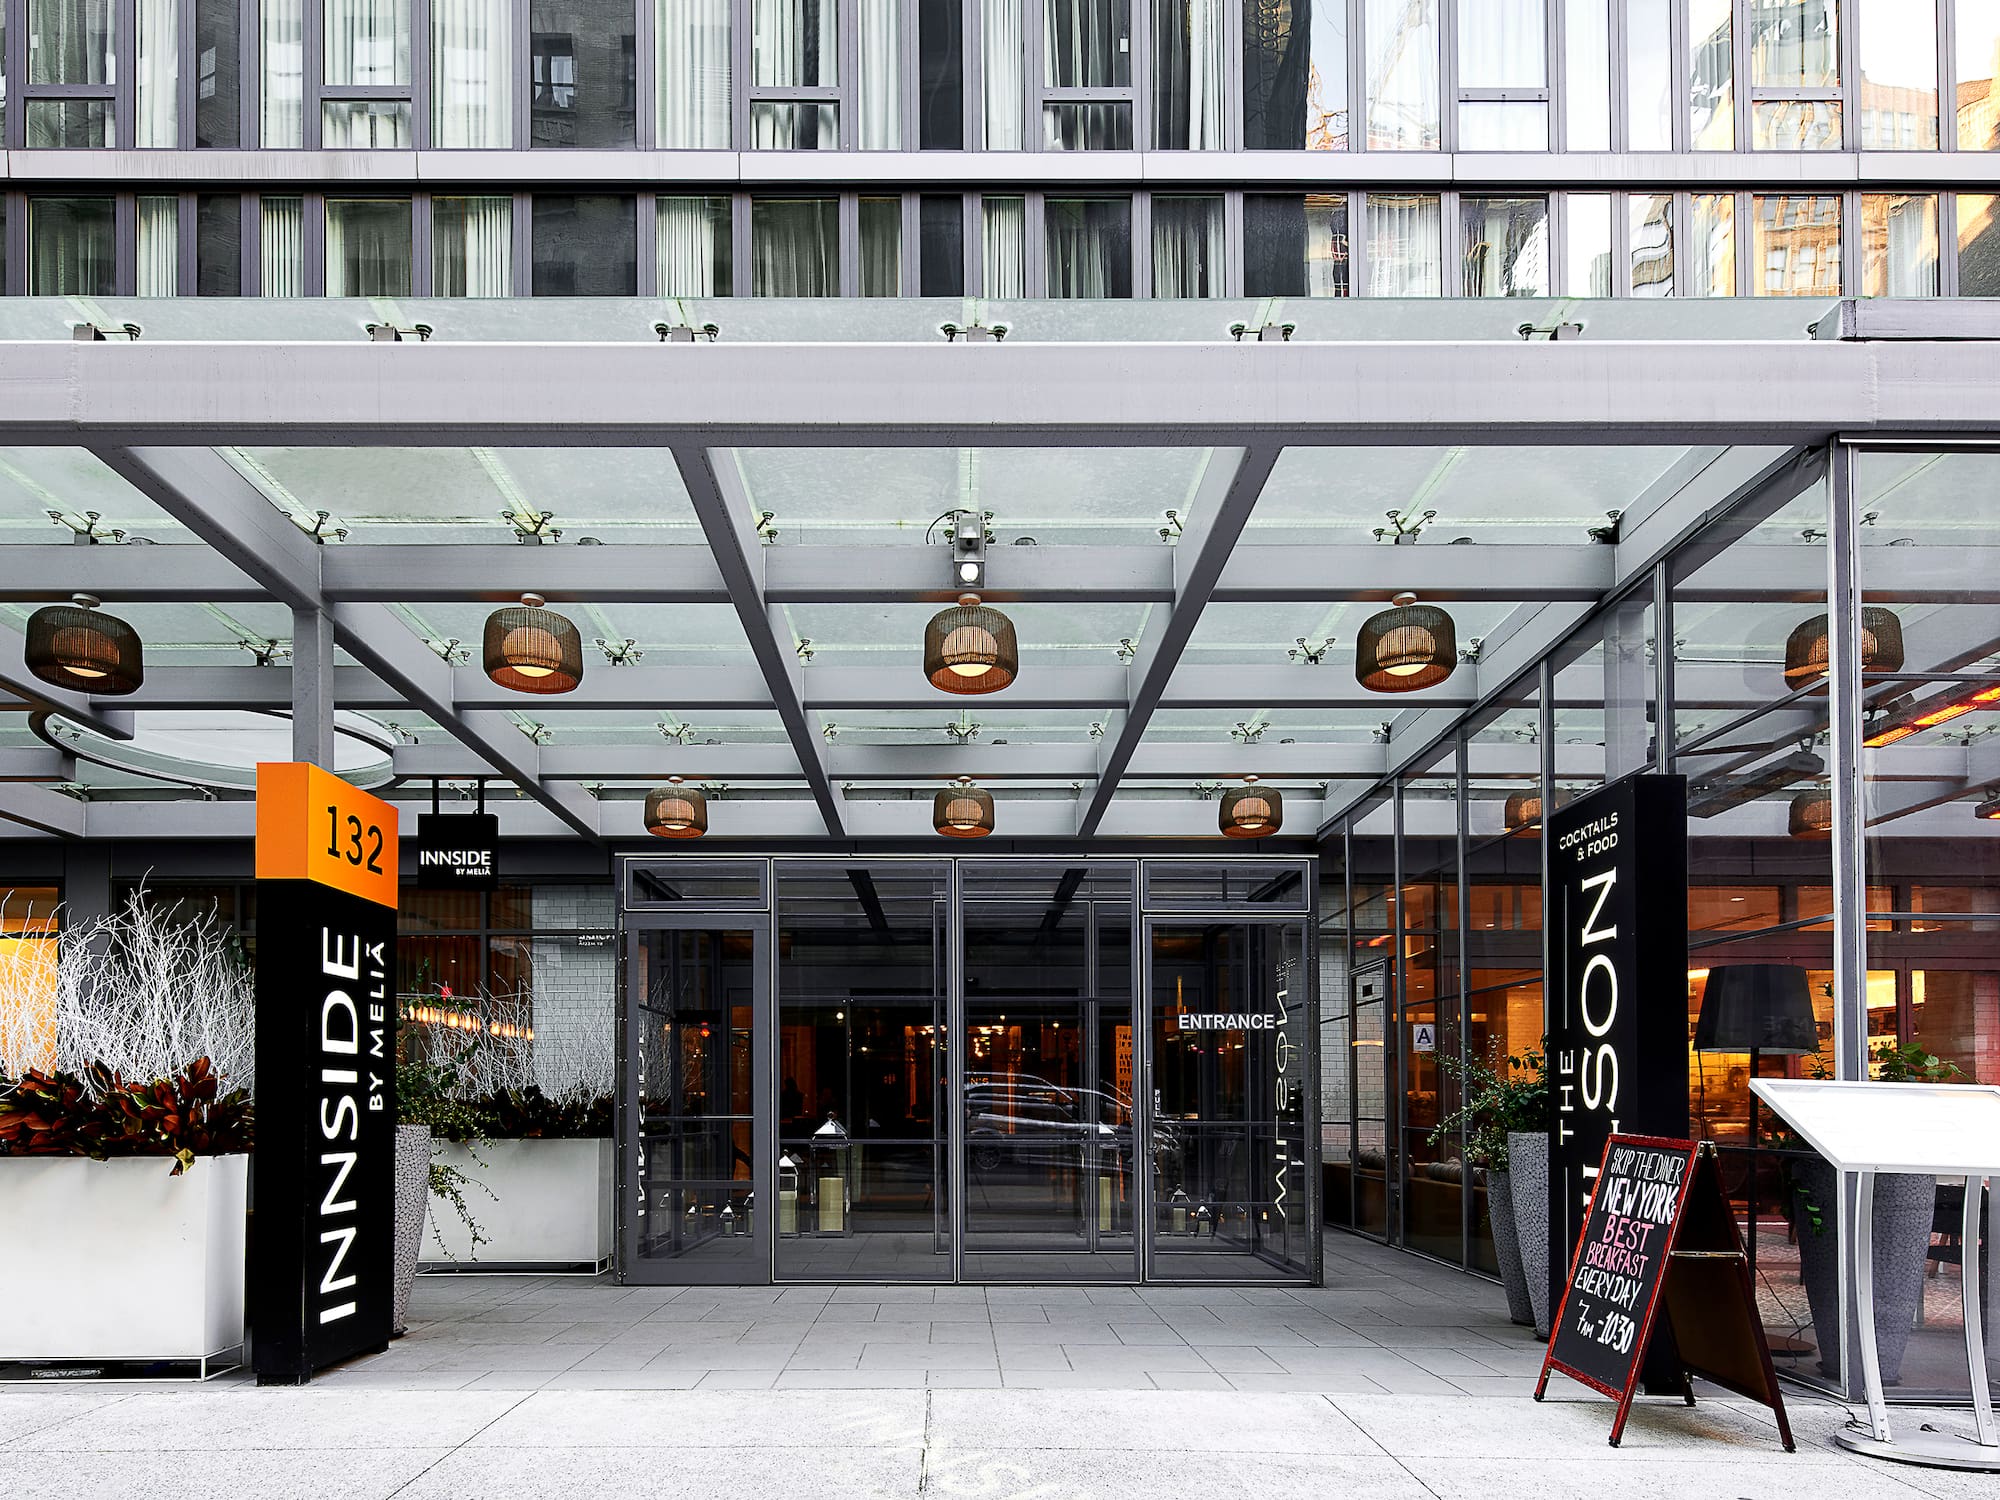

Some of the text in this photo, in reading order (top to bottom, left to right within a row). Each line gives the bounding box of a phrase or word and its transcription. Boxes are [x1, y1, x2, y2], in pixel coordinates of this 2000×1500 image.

[327, 805, 383, 876] 132
[1559, 812, 1618, 850] COCKTAILS
[1577, 833, 1618, 861] & FOOD
[420, 850, 491, 865] INNSIDE
[1178, 1014, 1274, 1030] ENTRANCE
[1417, 1028, 1431, 1043] A
[369, 1072, 384, 1110] BY
[1560, 1049, 1574, 1146] THE
[320, 926, 359, 1325] INNSIDE
[1611, 1147, 1635, 1175] SKIP
[1601, 1177, 1641, 1216] NEW
[1602, 1215, 1654, 1252] BEST
[1585, 1241, 1649, 1279] BREAKFAST
[1575, 1266, 1643, 1311] EVERYDAY
